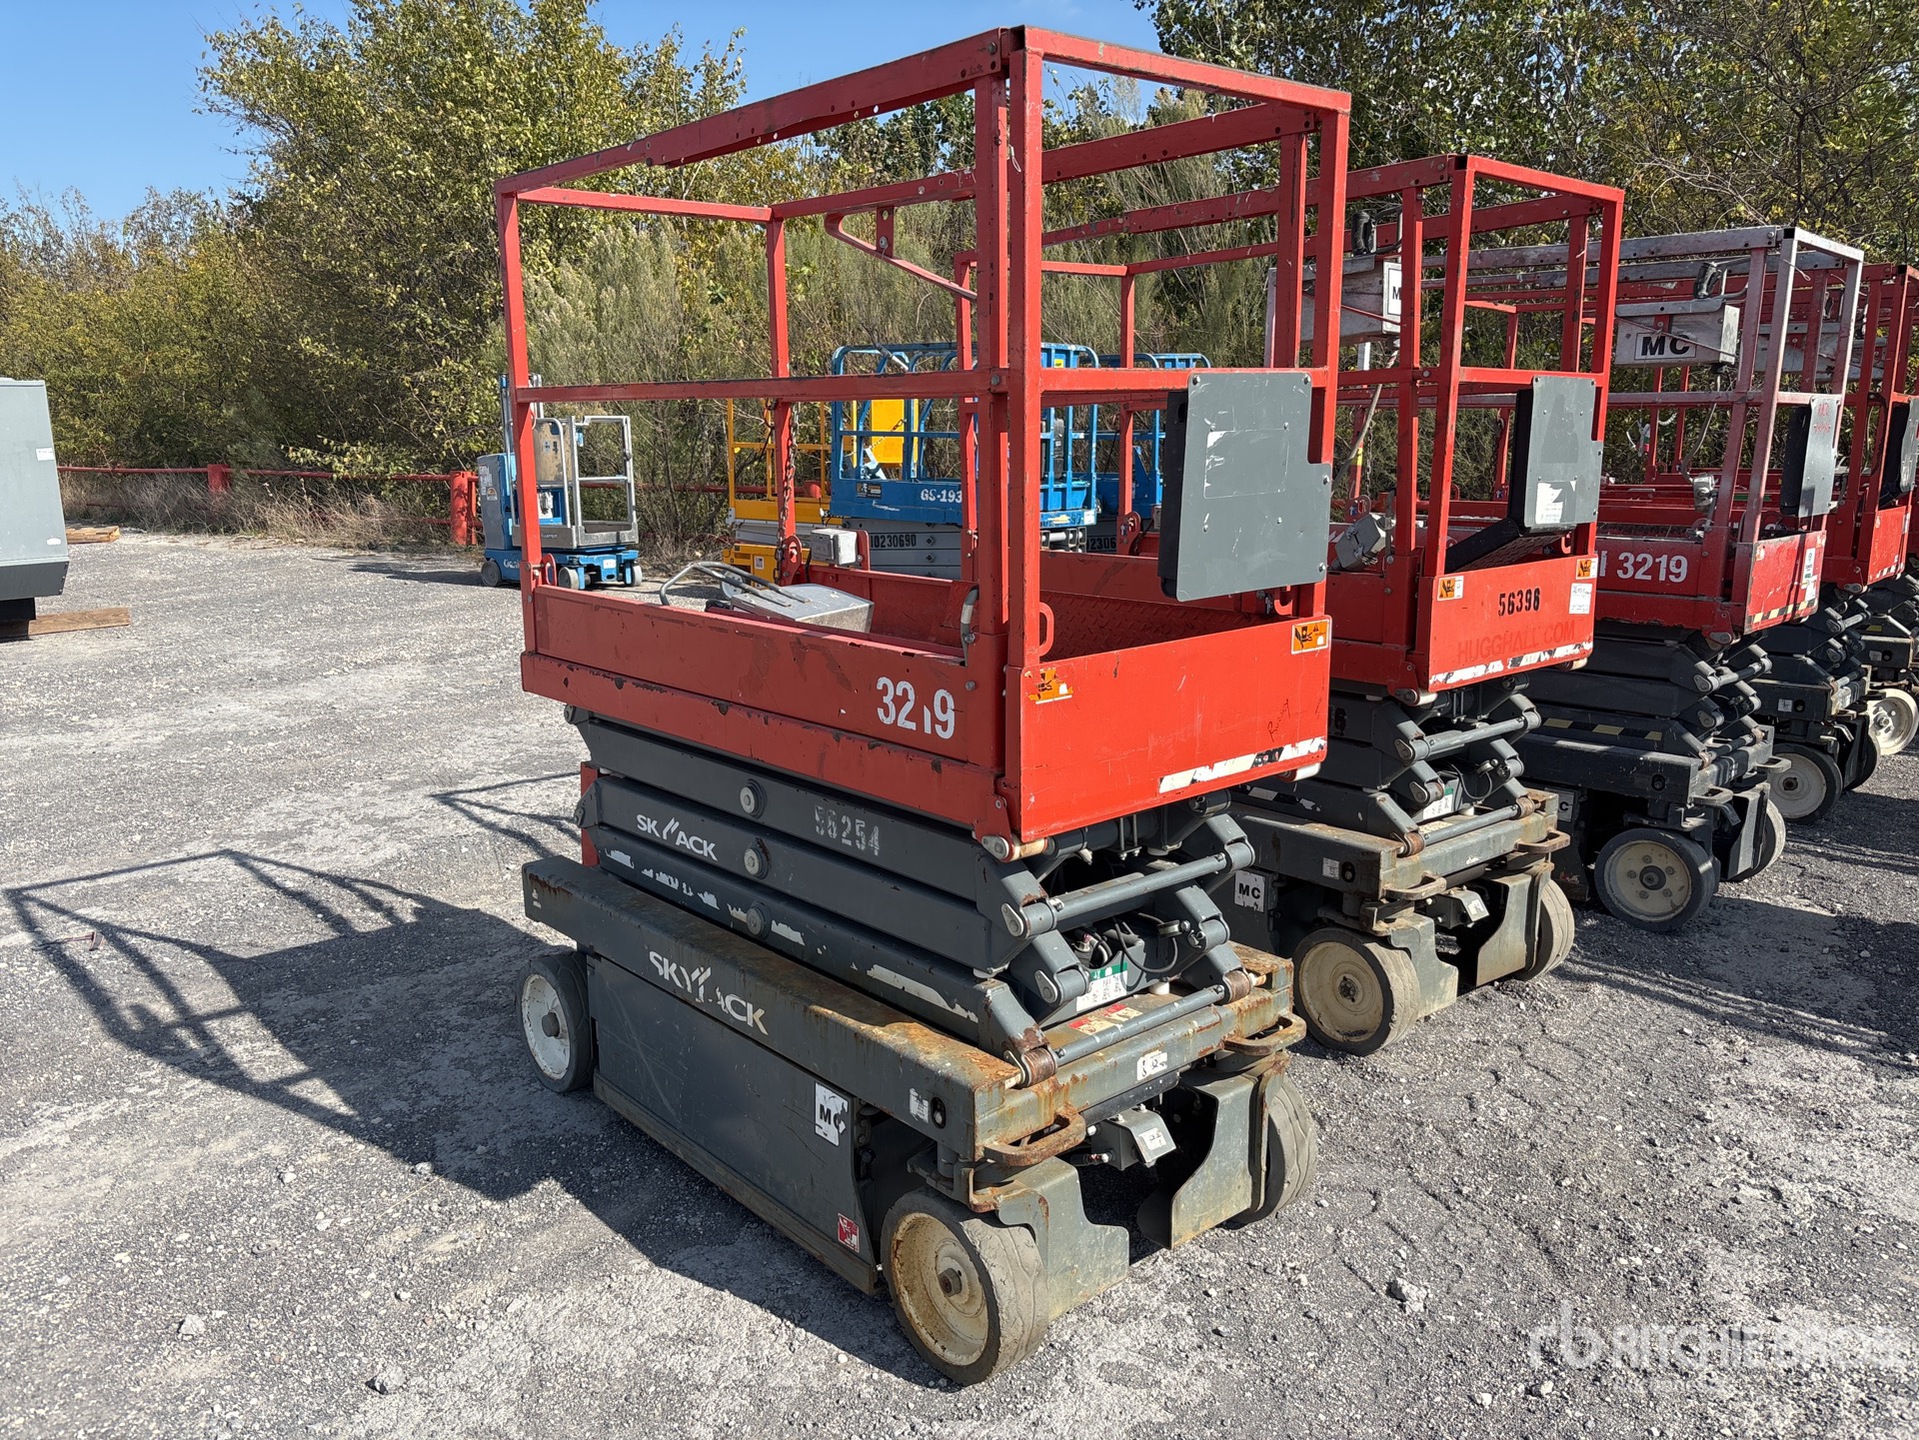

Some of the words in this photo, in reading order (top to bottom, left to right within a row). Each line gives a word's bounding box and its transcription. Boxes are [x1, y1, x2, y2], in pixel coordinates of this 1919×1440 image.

[1640, 334, 1690, 356] MC
[1616, 552, 1688, 583] 3219
[876, 676, 955, 739] 3219
[814, 805, 880, 857] 56254
[1239, 882, 1261, 900] MC
